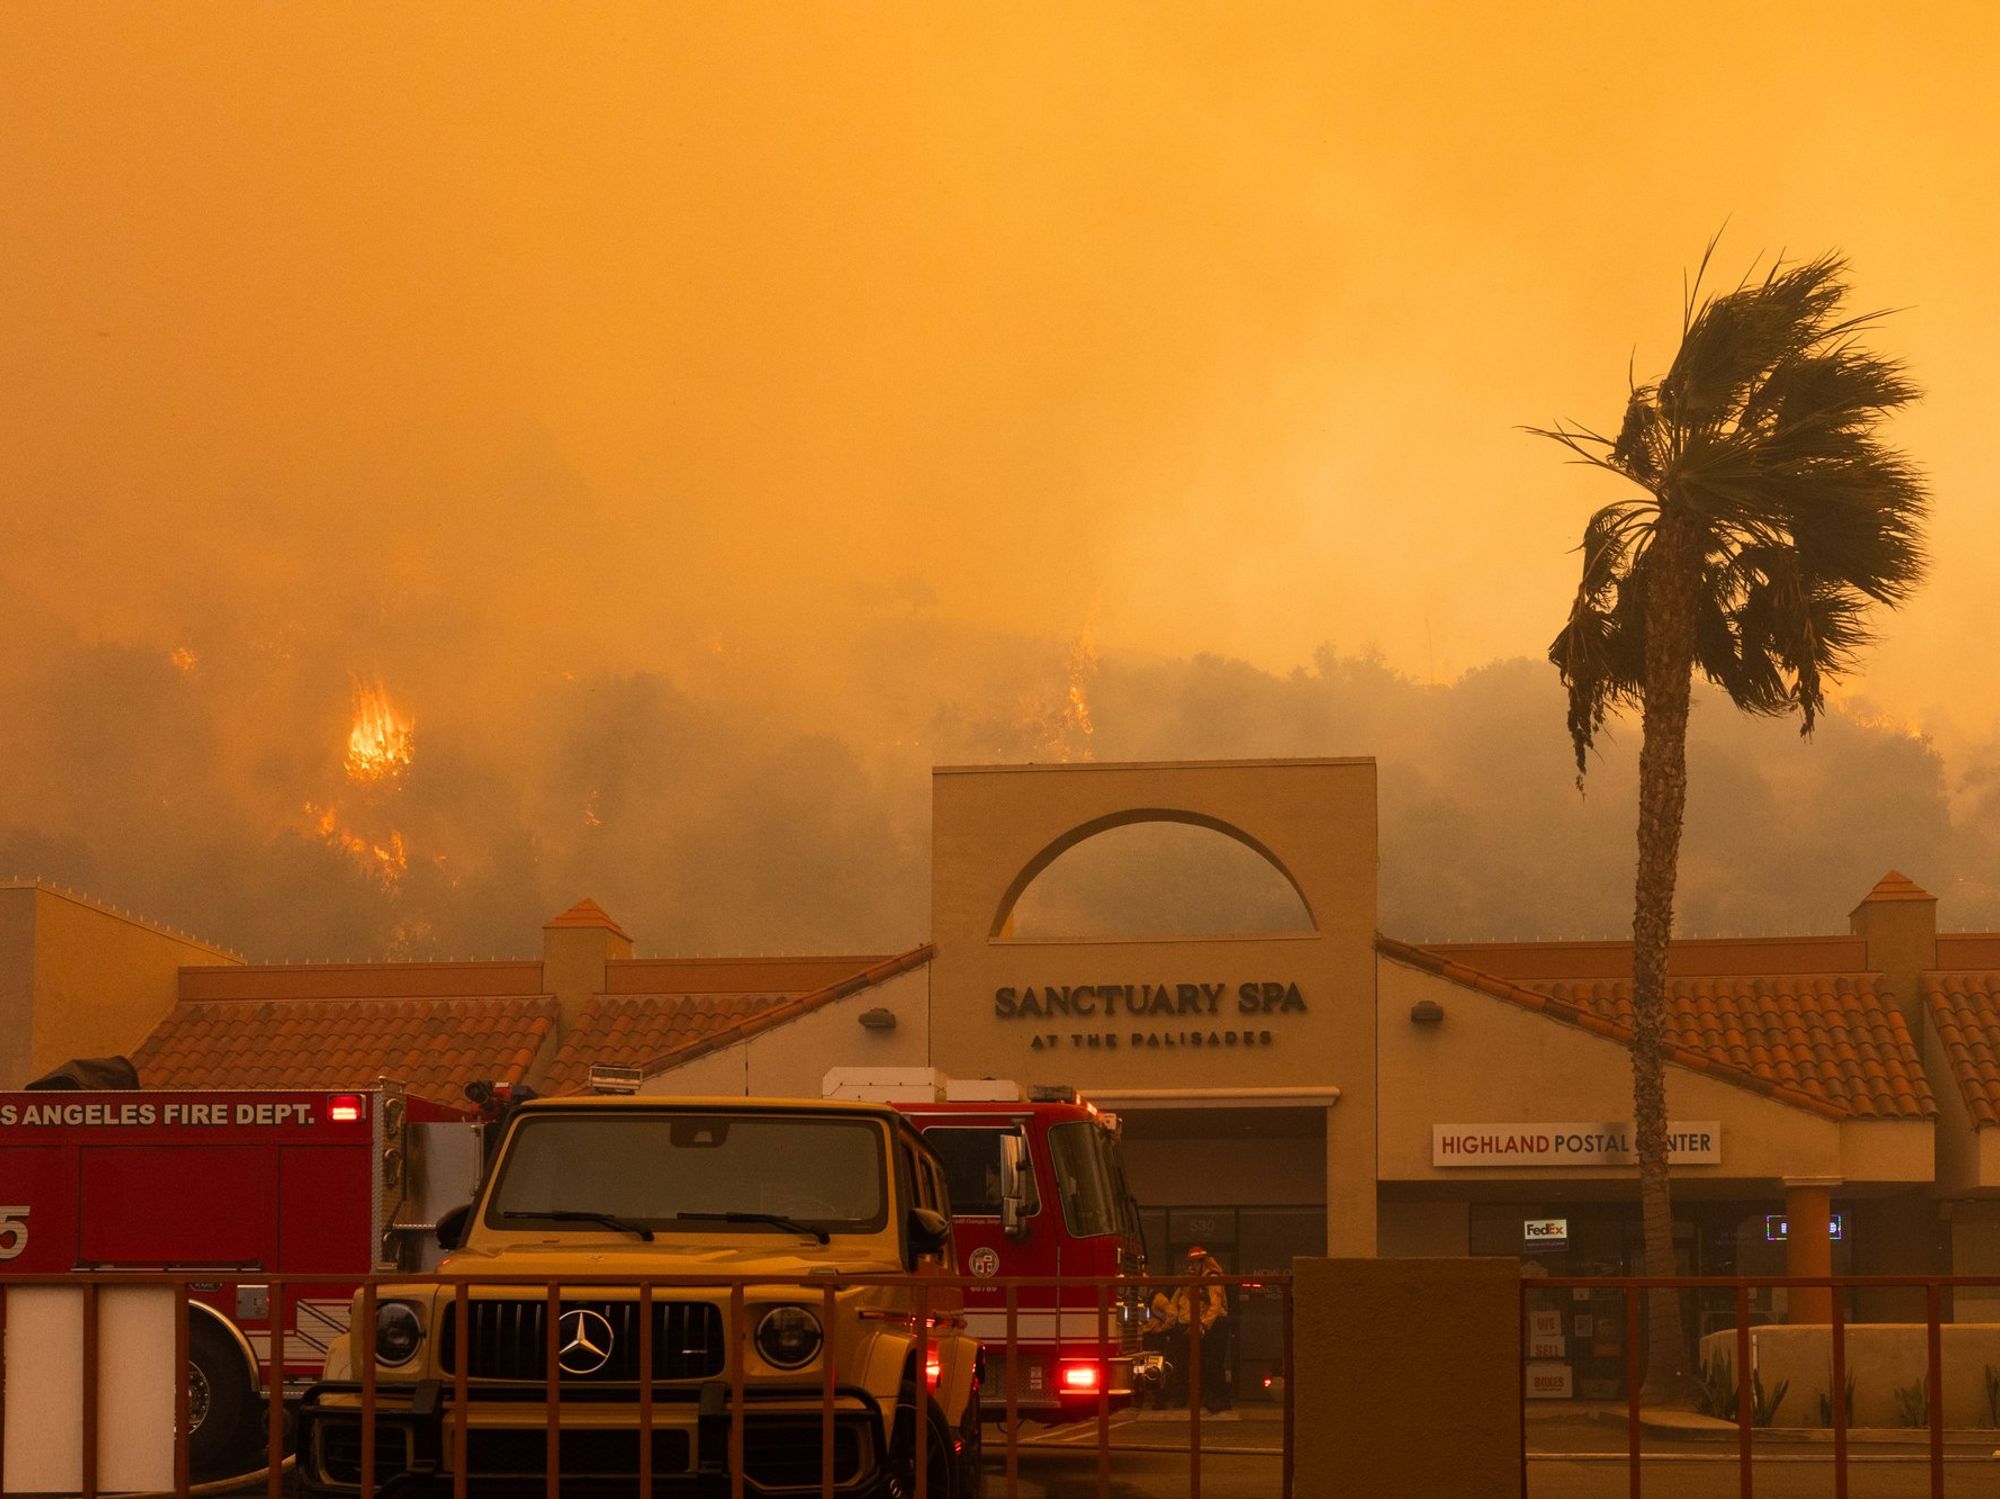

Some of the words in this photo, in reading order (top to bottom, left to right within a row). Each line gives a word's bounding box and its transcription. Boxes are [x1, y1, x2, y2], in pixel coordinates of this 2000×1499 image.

[995, 984, 1225, 1017] SANCTUARY
[1238, 981, 1308, 1013] SPA
[1031, 1034, 1059, 1048] AT
[1071, 1033, 1118, 1048] THE
[1131, 1030, 1272, 1048] PALISADES
[21, 1104, 157, 1126] ANGELES
[164, 1104, 228, 1125] FIRE
[236, 1103, 315, 1125] DEPT.
[1442, 1136, 1550, 1154] HIGHLAND
[1554, 1135, 1629, 1153] POSTAL
[1526, 1223, 1564, 1236] FedEx
[1537, 1317, 1556, 1331] WE
[1534, 1376, 1565, 1388] BOXES
